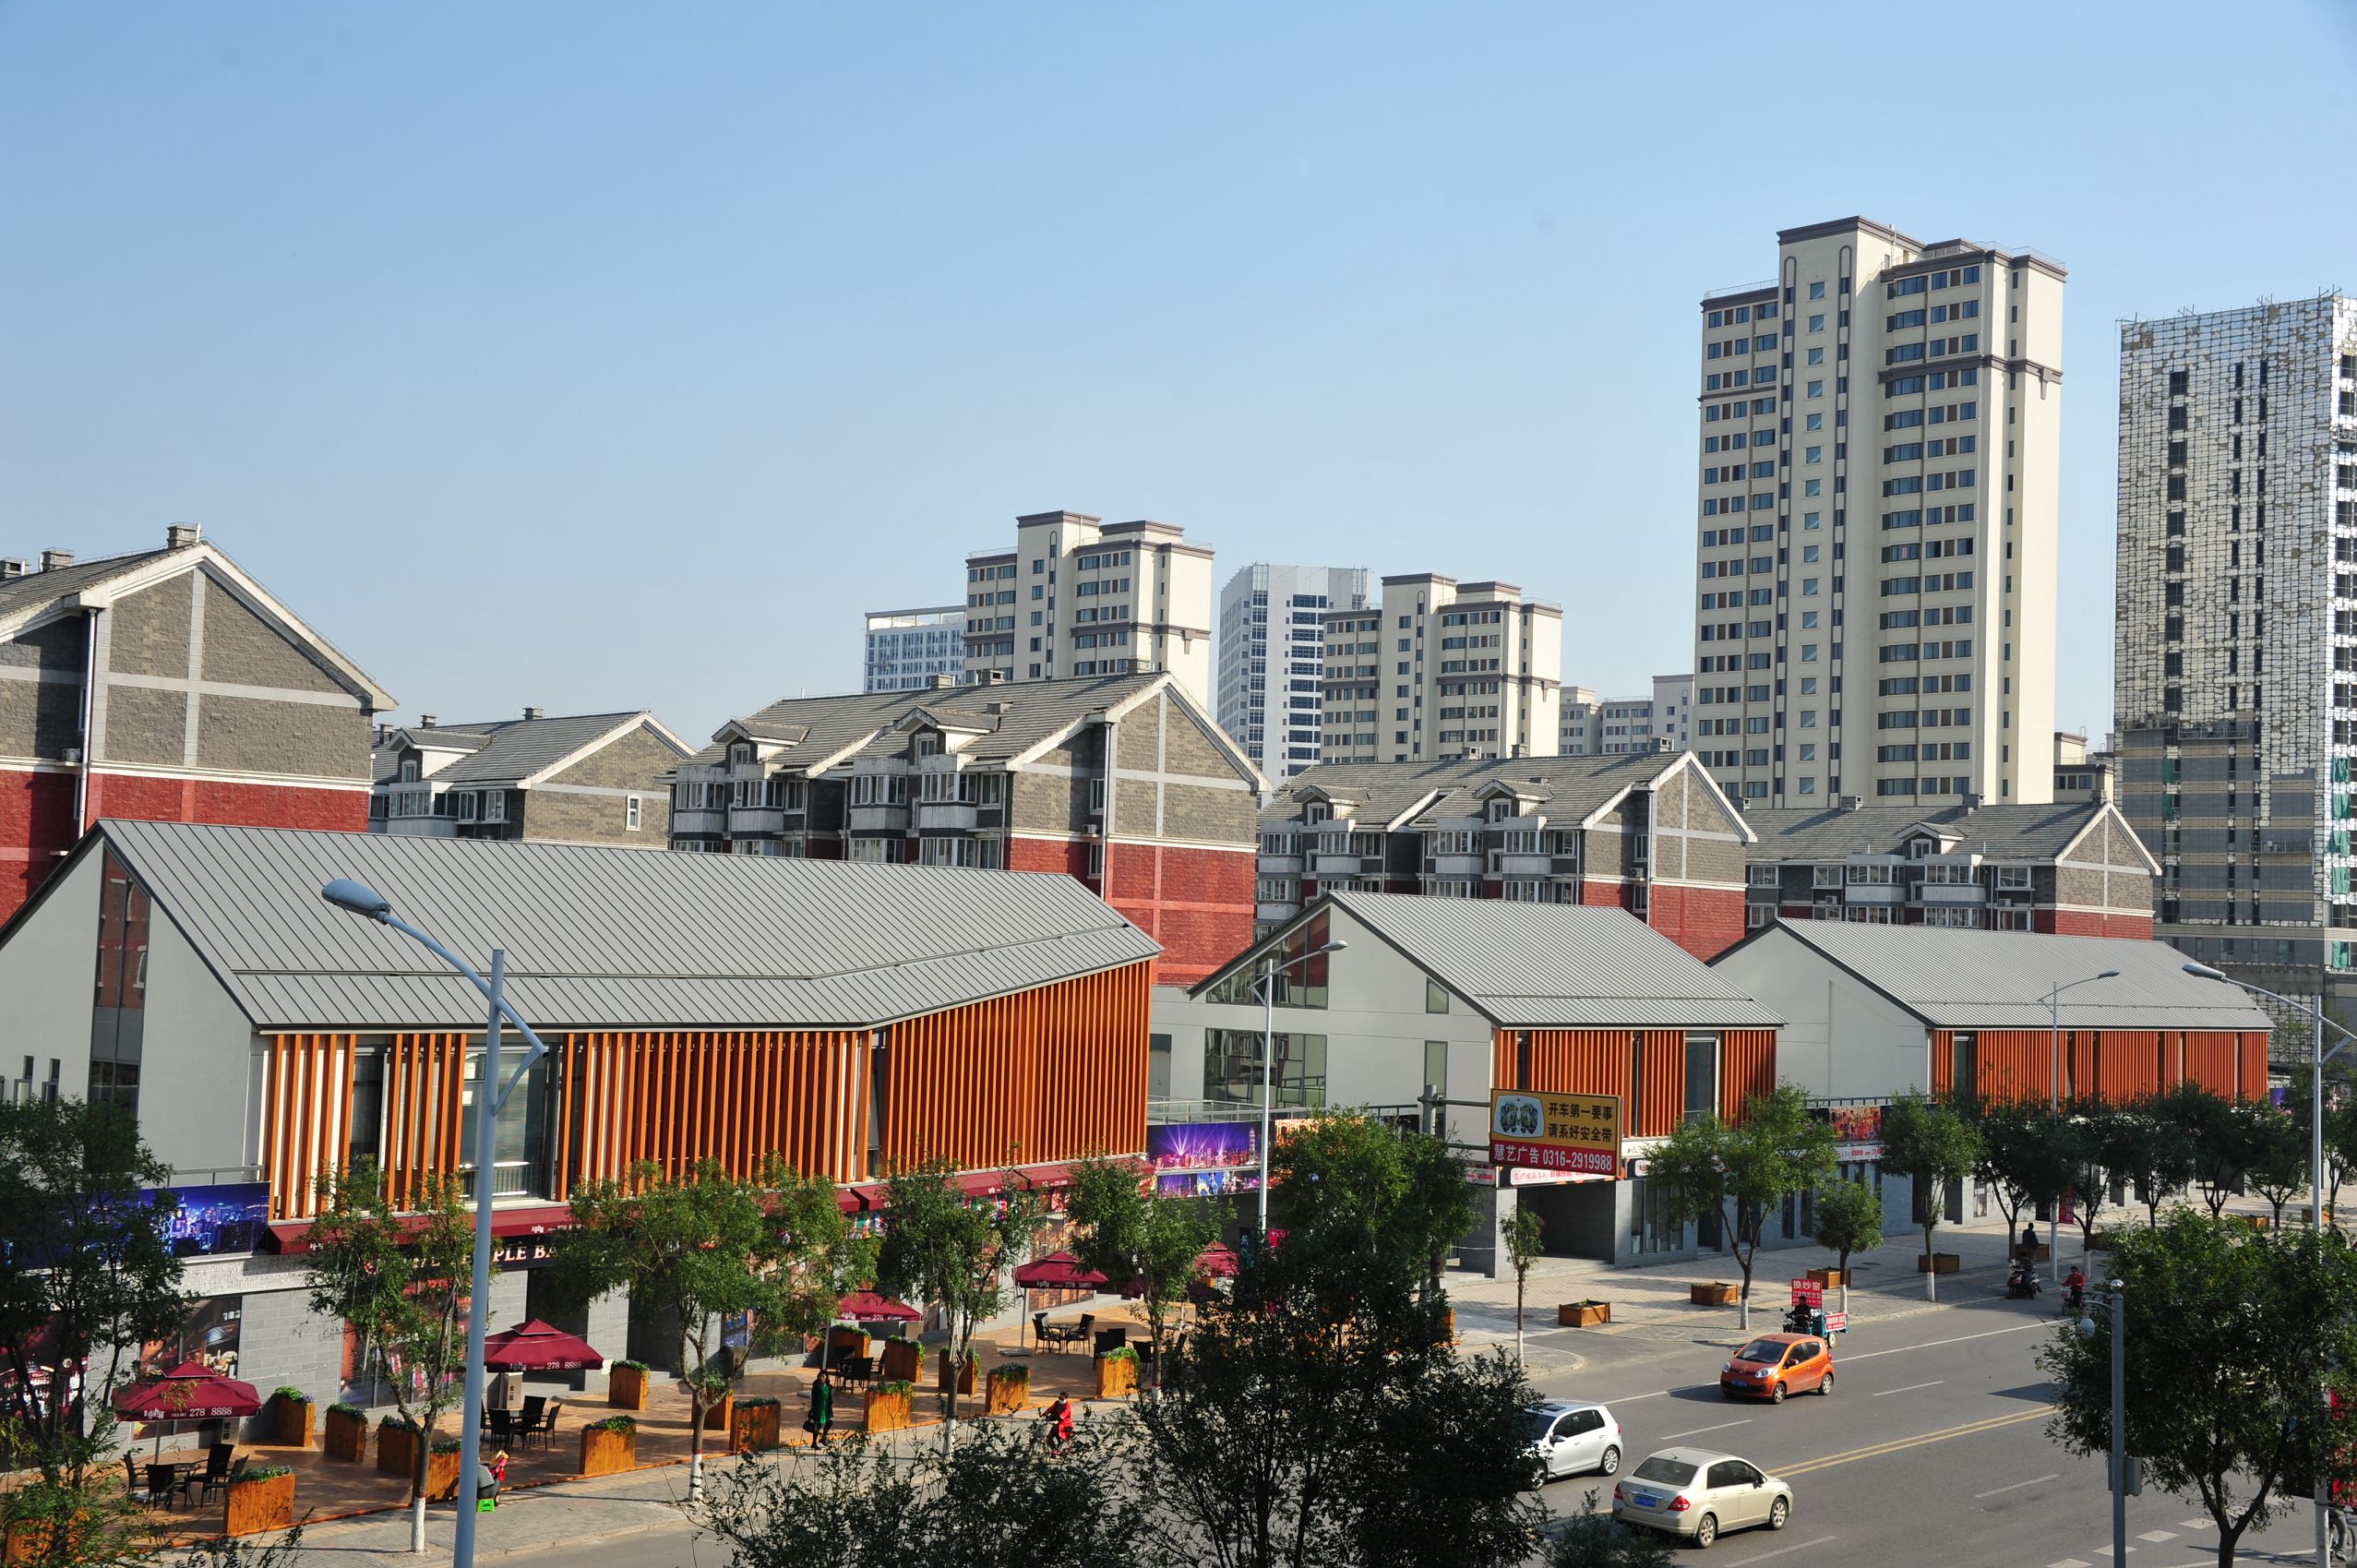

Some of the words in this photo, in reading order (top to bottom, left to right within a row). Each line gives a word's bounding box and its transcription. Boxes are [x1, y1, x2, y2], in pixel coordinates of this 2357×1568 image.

[1548, 1102, 1613, 1121] 开车第一要事
[1548, 1123, 1612, 1143] 请系好安全带
[1494, 1143, 1539, 1165] 慧艺广告
[1542, 1149, 1612, 1171] 0316-2919988
[1793, 1279, 1821, 1291] 换纱窗
[546, 1361, 560, 1370] 278
[189, 1407, 206, 1418] 278
[210, 1406, 233, 1416] 8888
